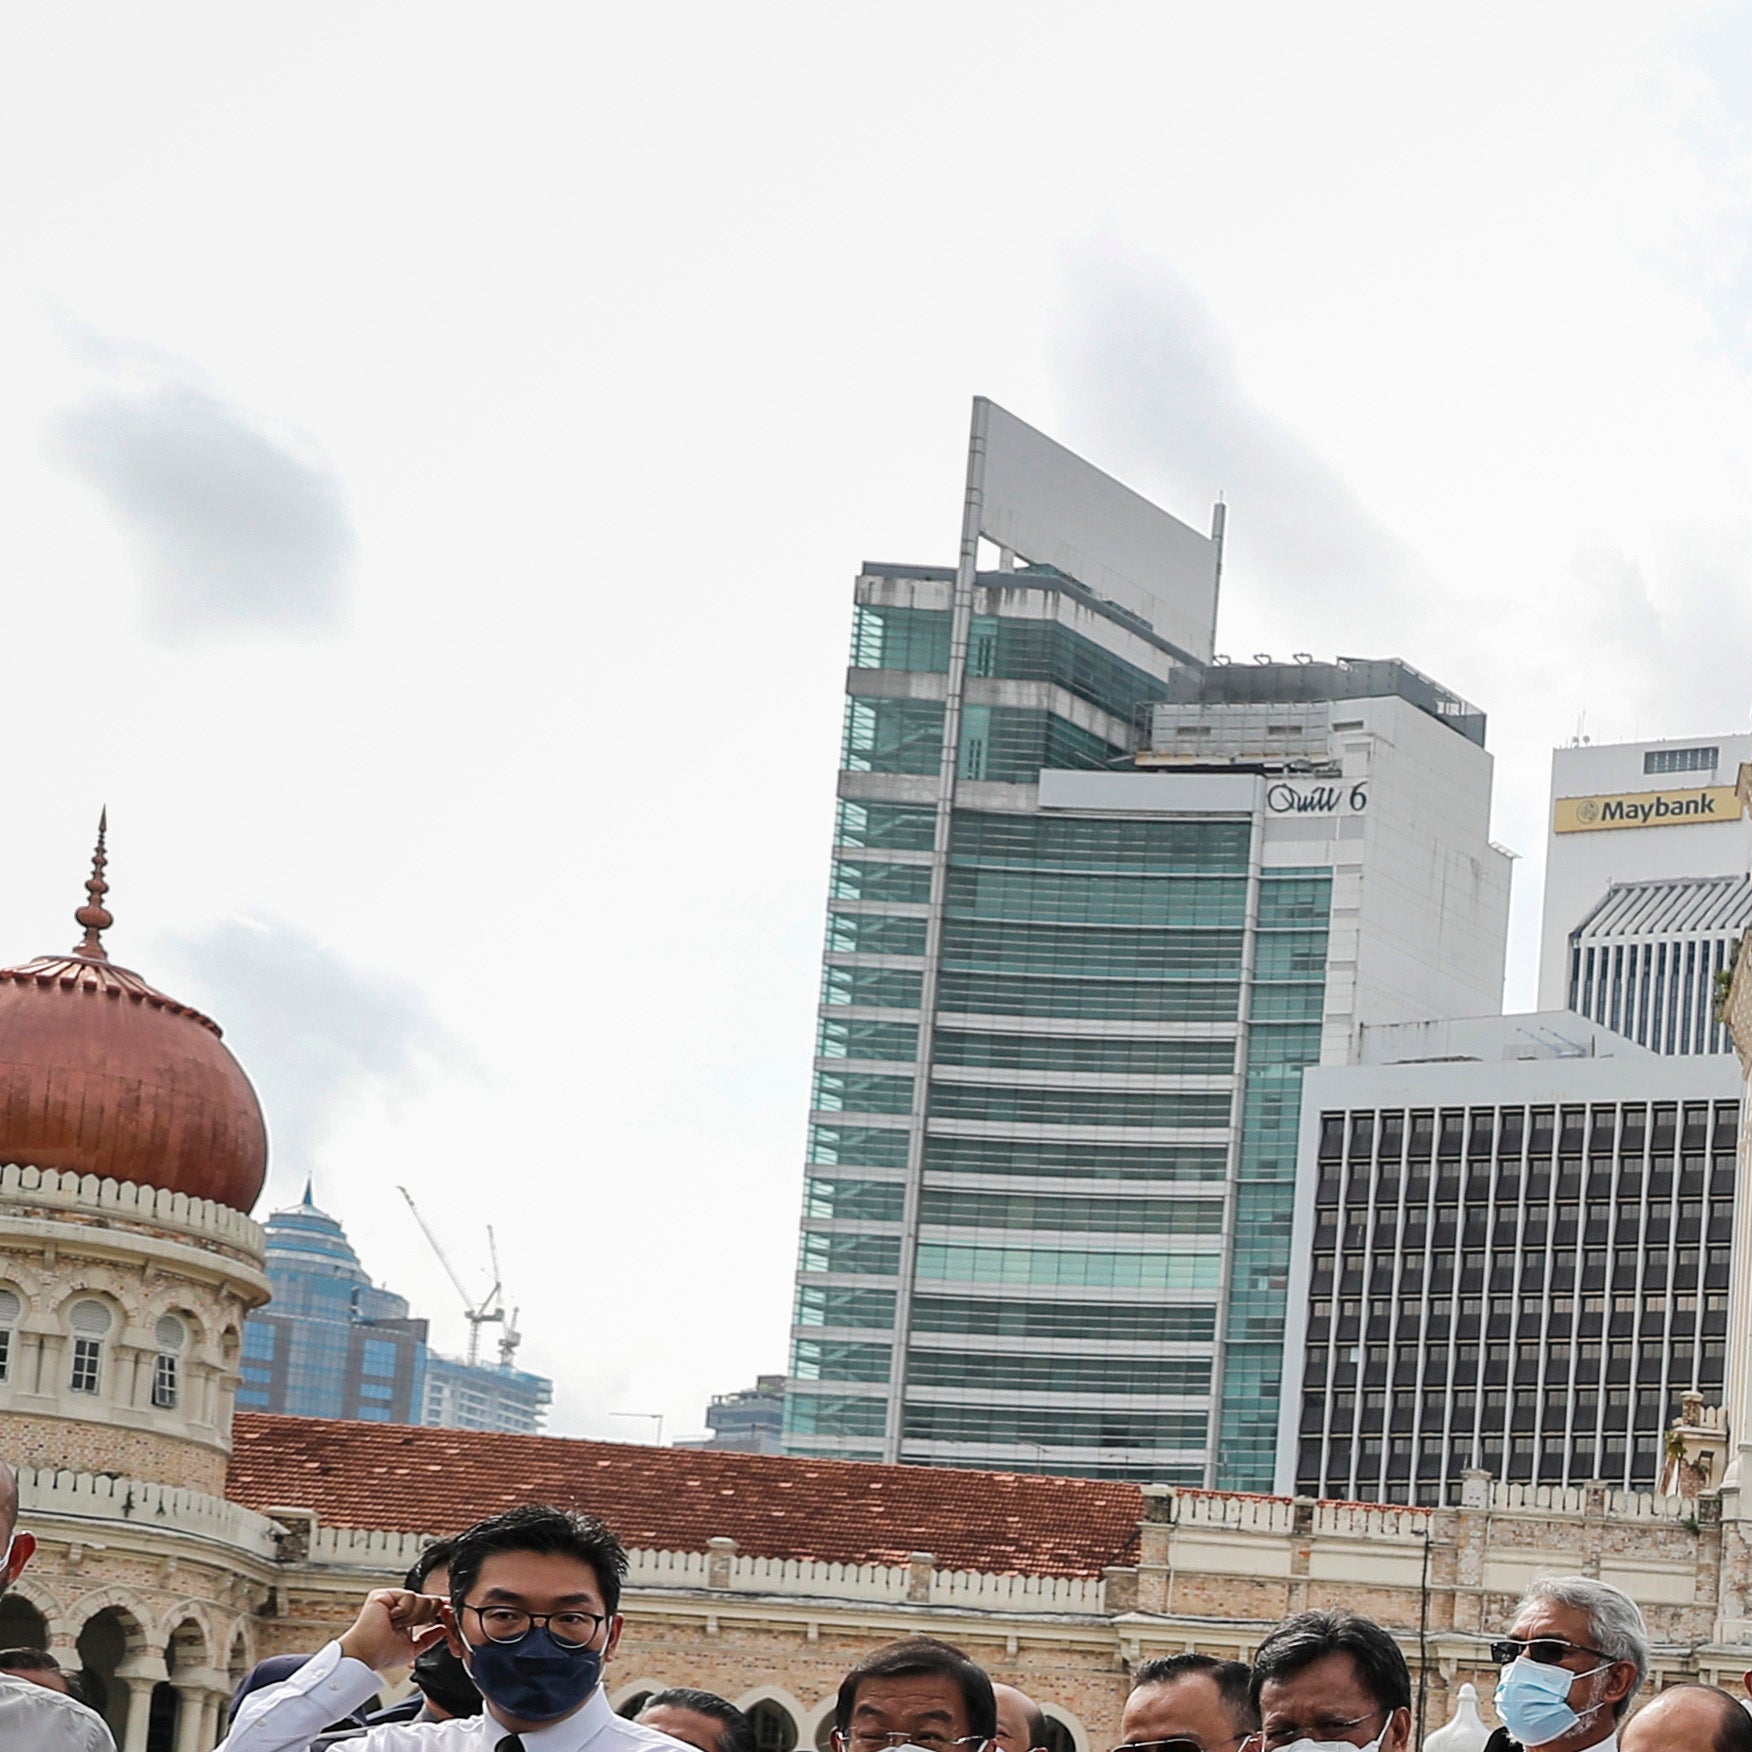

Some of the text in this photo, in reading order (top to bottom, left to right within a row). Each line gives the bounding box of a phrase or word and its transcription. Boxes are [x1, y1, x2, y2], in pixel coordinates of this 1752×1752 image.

[1268, 781, 1368, 813] Quill 6
[1601, 793, 1715, 823] Maybank
